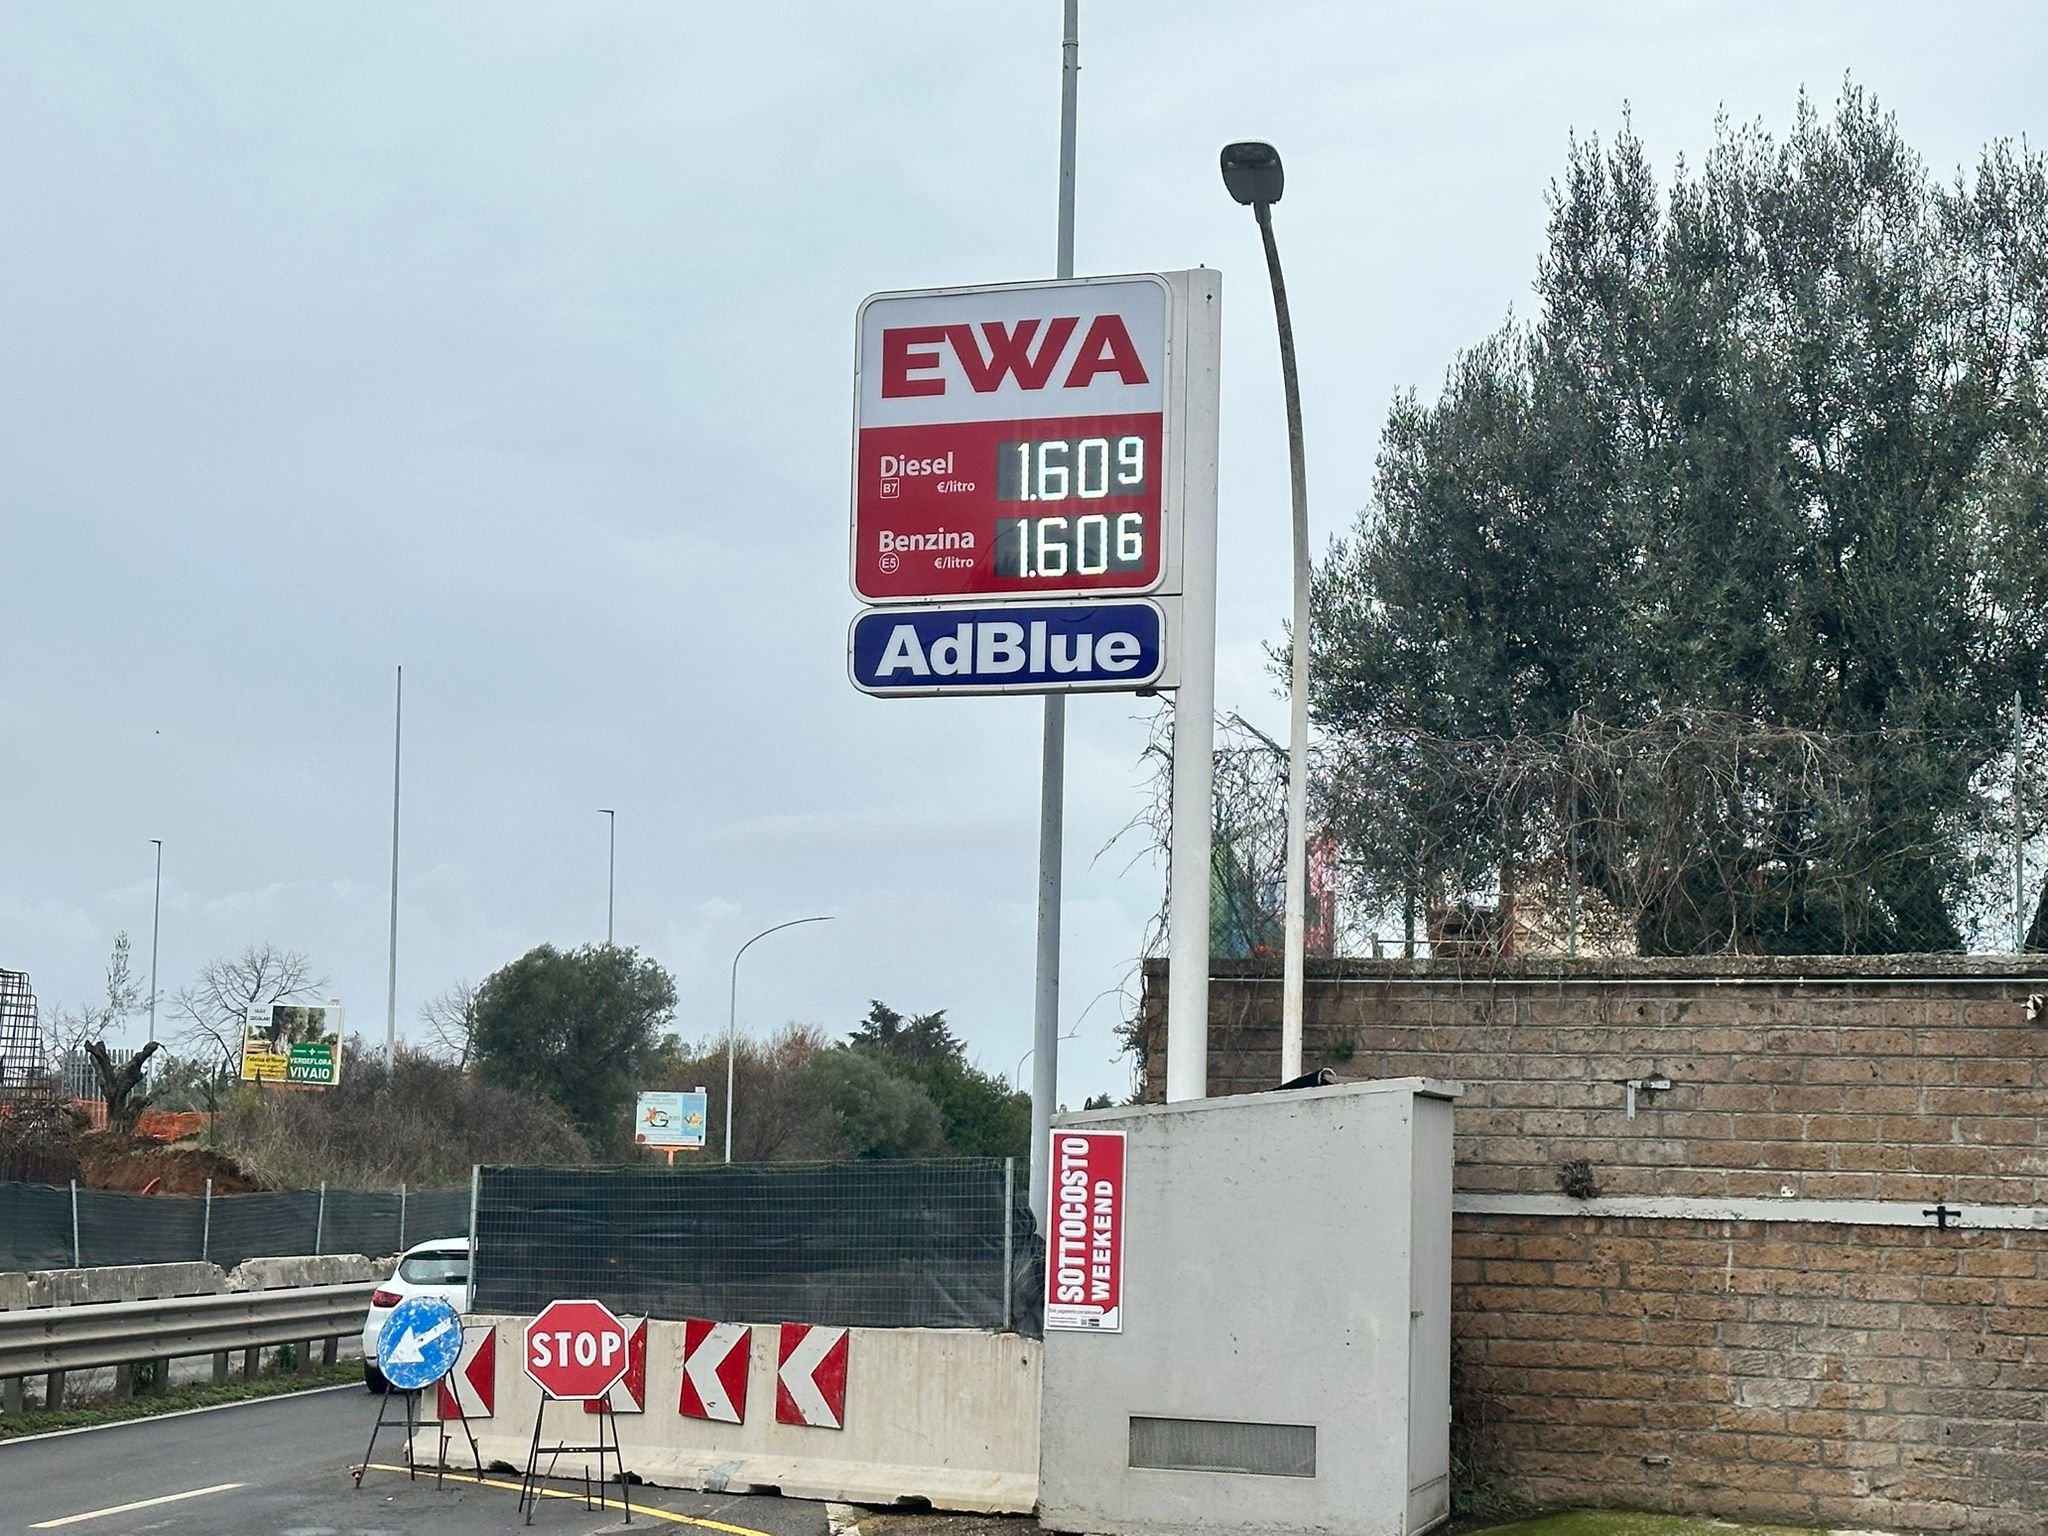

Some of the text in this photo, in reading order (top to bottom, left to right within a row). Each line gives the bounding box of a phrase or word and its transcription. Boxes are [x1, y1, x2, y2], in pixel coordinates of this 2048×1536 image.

[881, 313, 1150, 399] EWA
[880, 435, 1145, 501] Diesel 1.609
[883, 479, 976, 494] B7 €/litro
[879, 512, 1144, 578] Benzina 1.606
[881, 556, 974, 569] E5 €/litro
[874, 620, 1142, 678] AdBlue
[289, 1057, 332, 1066] VERDEFLORA
[290, 1066, 330, 1079] VIVAIO
[1057, 1136, 1090, 1304] SOTTOCOSTO
[1091, 1180, 1114, 1302] WEEKEND
[531, 1331, 622, 1368] STOP
